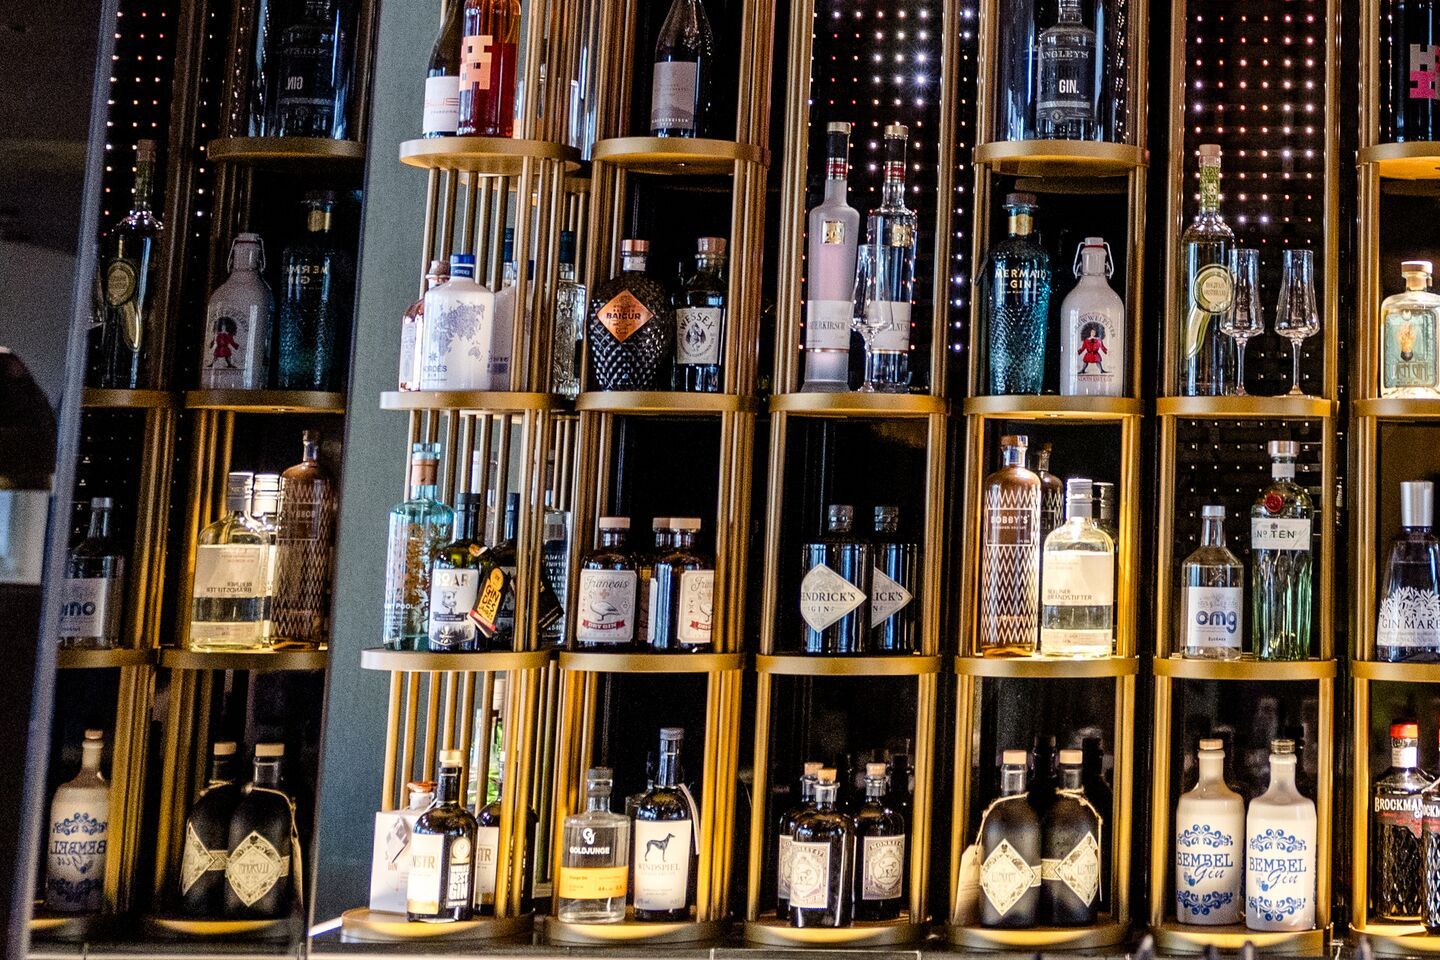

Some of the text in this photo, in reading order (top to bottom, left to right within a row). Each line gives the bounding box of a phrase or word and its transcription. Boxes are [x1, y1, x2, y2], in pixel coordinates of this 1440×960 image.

[1059, 79, 1080, 93] GIN.
[995, 269, 1047, 280] MERMAID
[1010, 279, 1032, 289] GIN
[680, 312, 715, 331] WESSEX
[990, 514, 1028, 524] BOBBY'S
[1272, 530, 1295, 539] TEN
[585, 576, 629, 590] François
[800, 592, 856, 602] ENDRICK'S
[588, 622, 602, 630] DRY
[1196, 610, 1237, 633] omg
[1382, 618, 1440, 629] GIN MARE
[570, 846, 610, 854] GOLDJUNGE
[1177, 853, 1233, 868] BEMBEL
[1249, 858, 1306, 873] BEMBEL
[638, 863, 681, 871] WINDSPIEL
[1195, 863, 1225, 884] Gin
[1268, 868, 1298, 889] Gin
